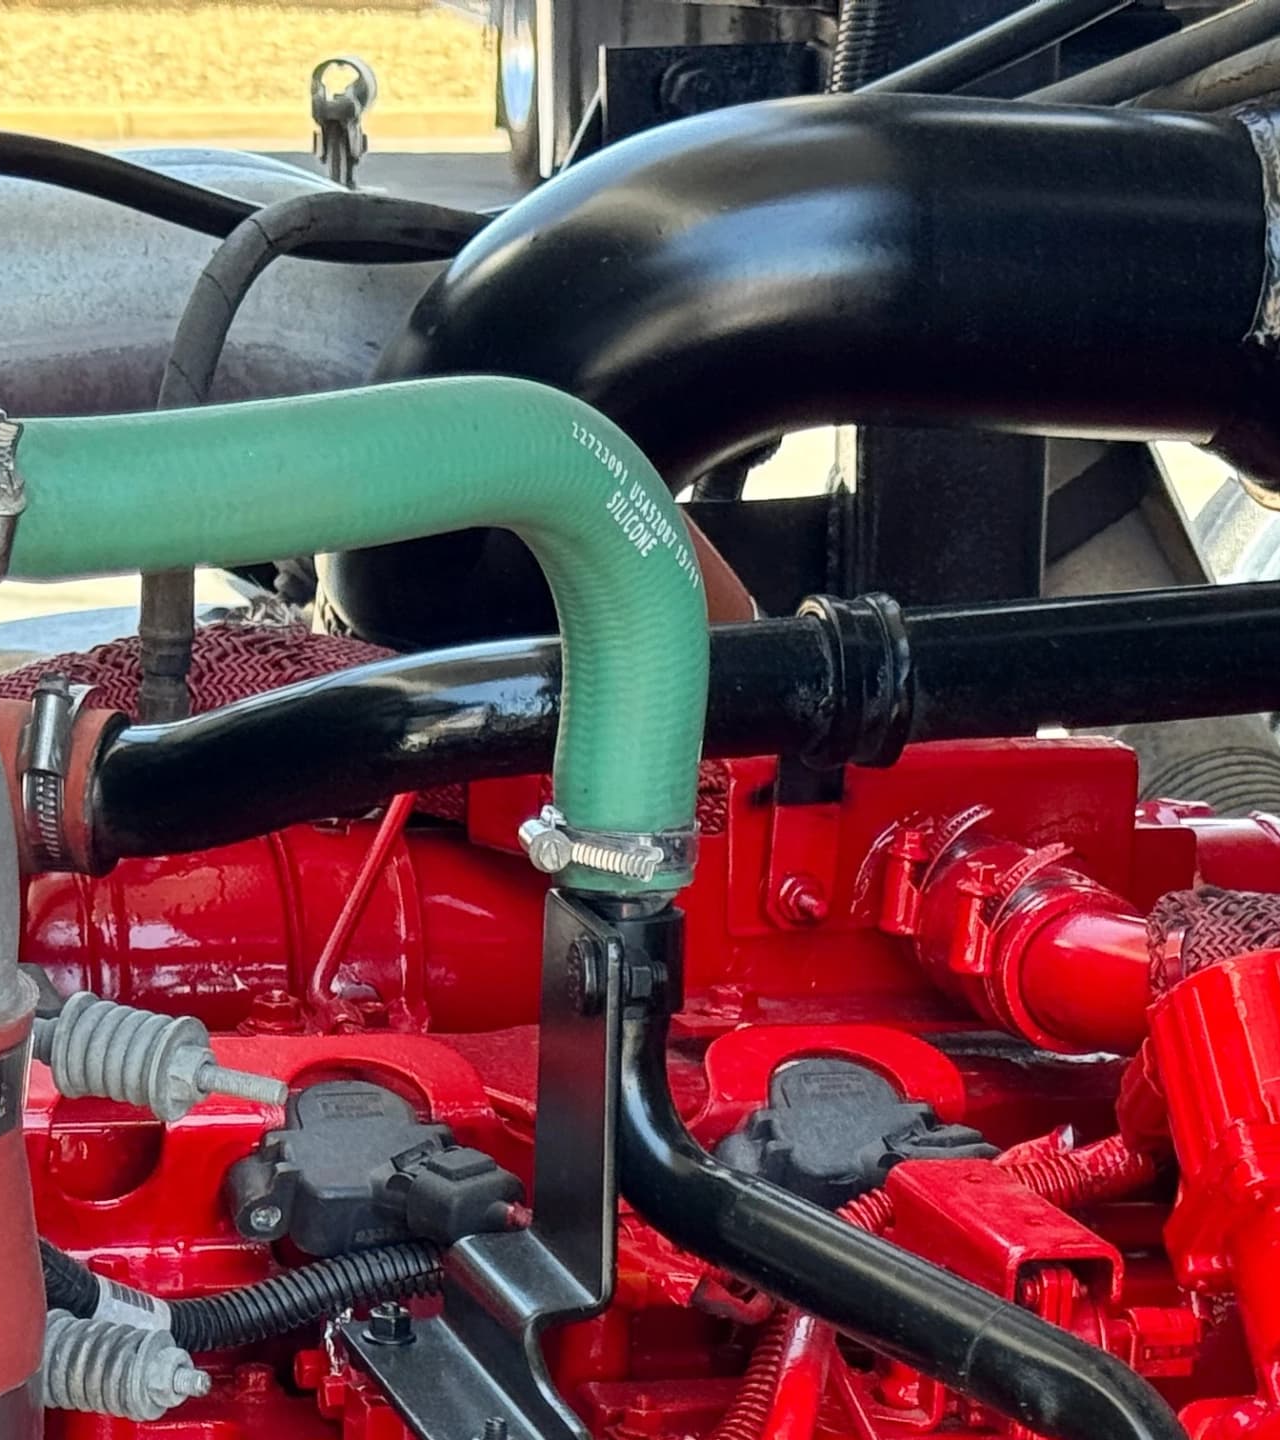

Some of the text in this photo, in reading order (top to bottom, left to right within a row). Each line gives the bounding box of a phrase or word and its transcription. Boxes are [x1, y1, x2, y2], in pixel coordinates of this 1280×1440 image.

[572, 421, 628, 486] 22723091
[629, 481, 678, 548] USA52087
[606, 490, 658, 557] SILICONE
